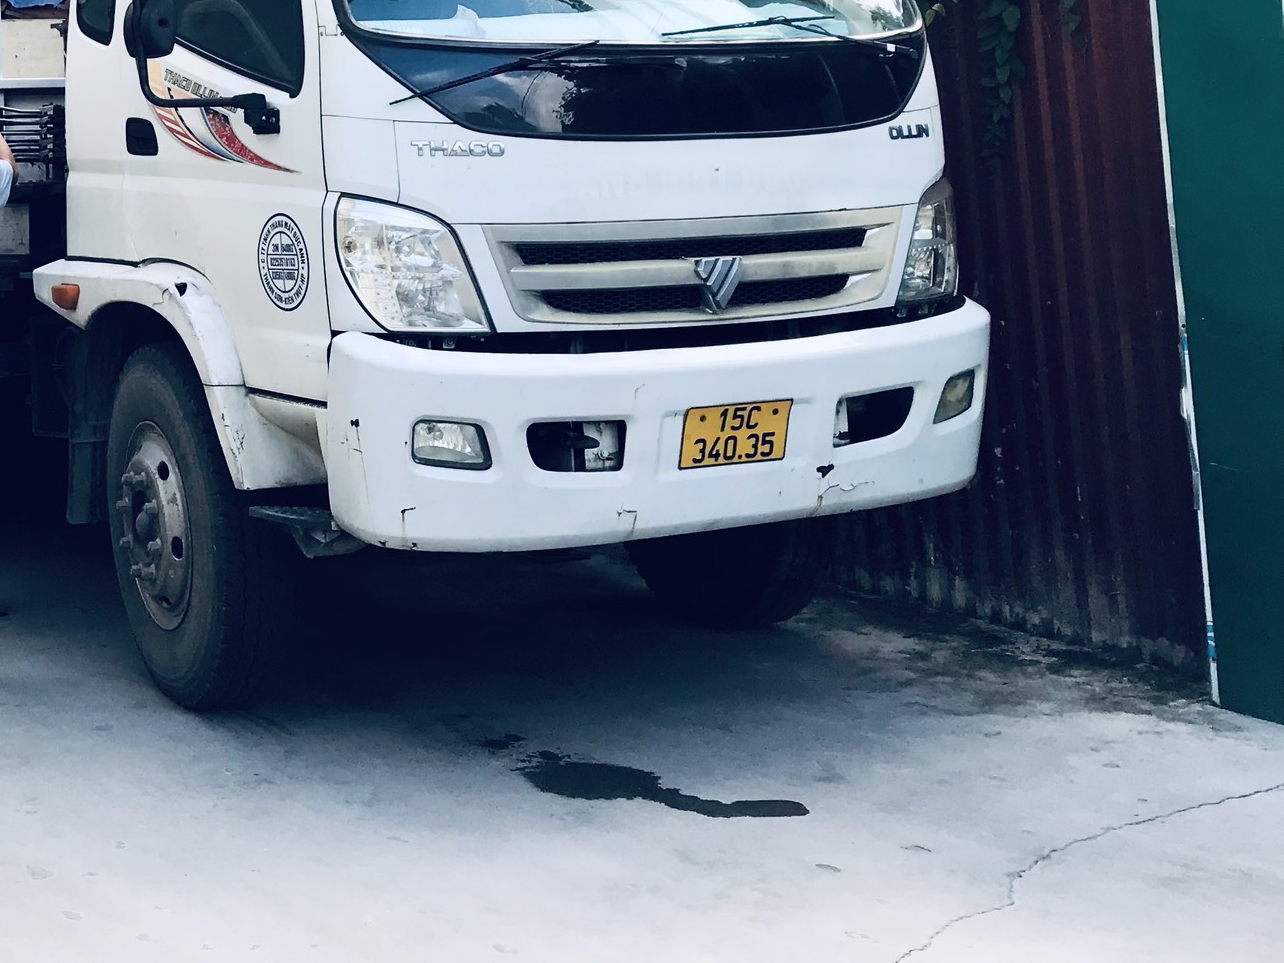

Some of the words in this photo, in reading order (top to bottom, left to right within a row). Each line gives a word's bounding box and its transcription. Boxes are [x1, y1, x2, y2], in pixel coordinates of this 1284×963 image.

[888, 123, 930, 141] OLLIN
[410, 140, 506, 158] THACO
[719, 405, 762, 432] 15C
[691, 431, 776, 464] 340.35
